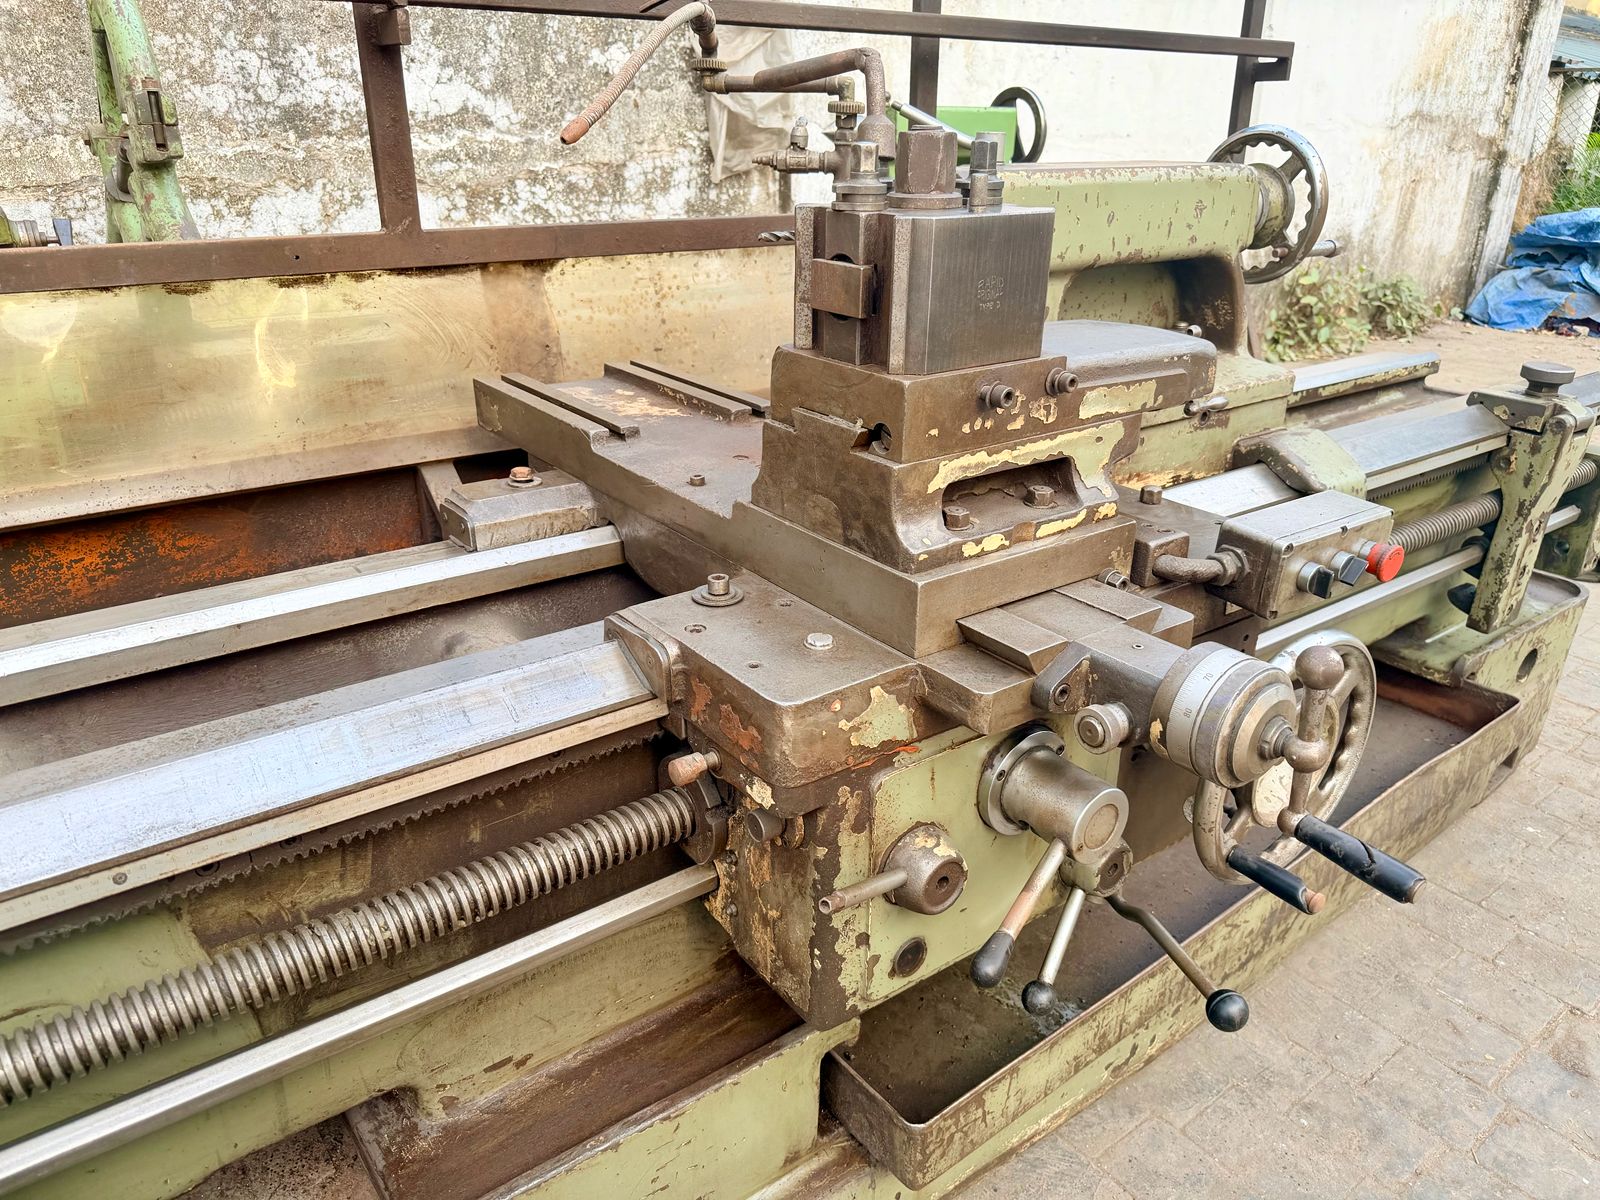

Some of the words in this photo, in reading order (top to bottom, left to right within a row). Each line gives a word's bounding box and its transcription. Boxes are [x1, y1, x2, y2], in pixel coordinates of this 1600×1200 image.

[979, 302, 994, 311] TYPE
[1202, 672, 1214, 682] 70
[1183, 707, 1193, 719] 80
